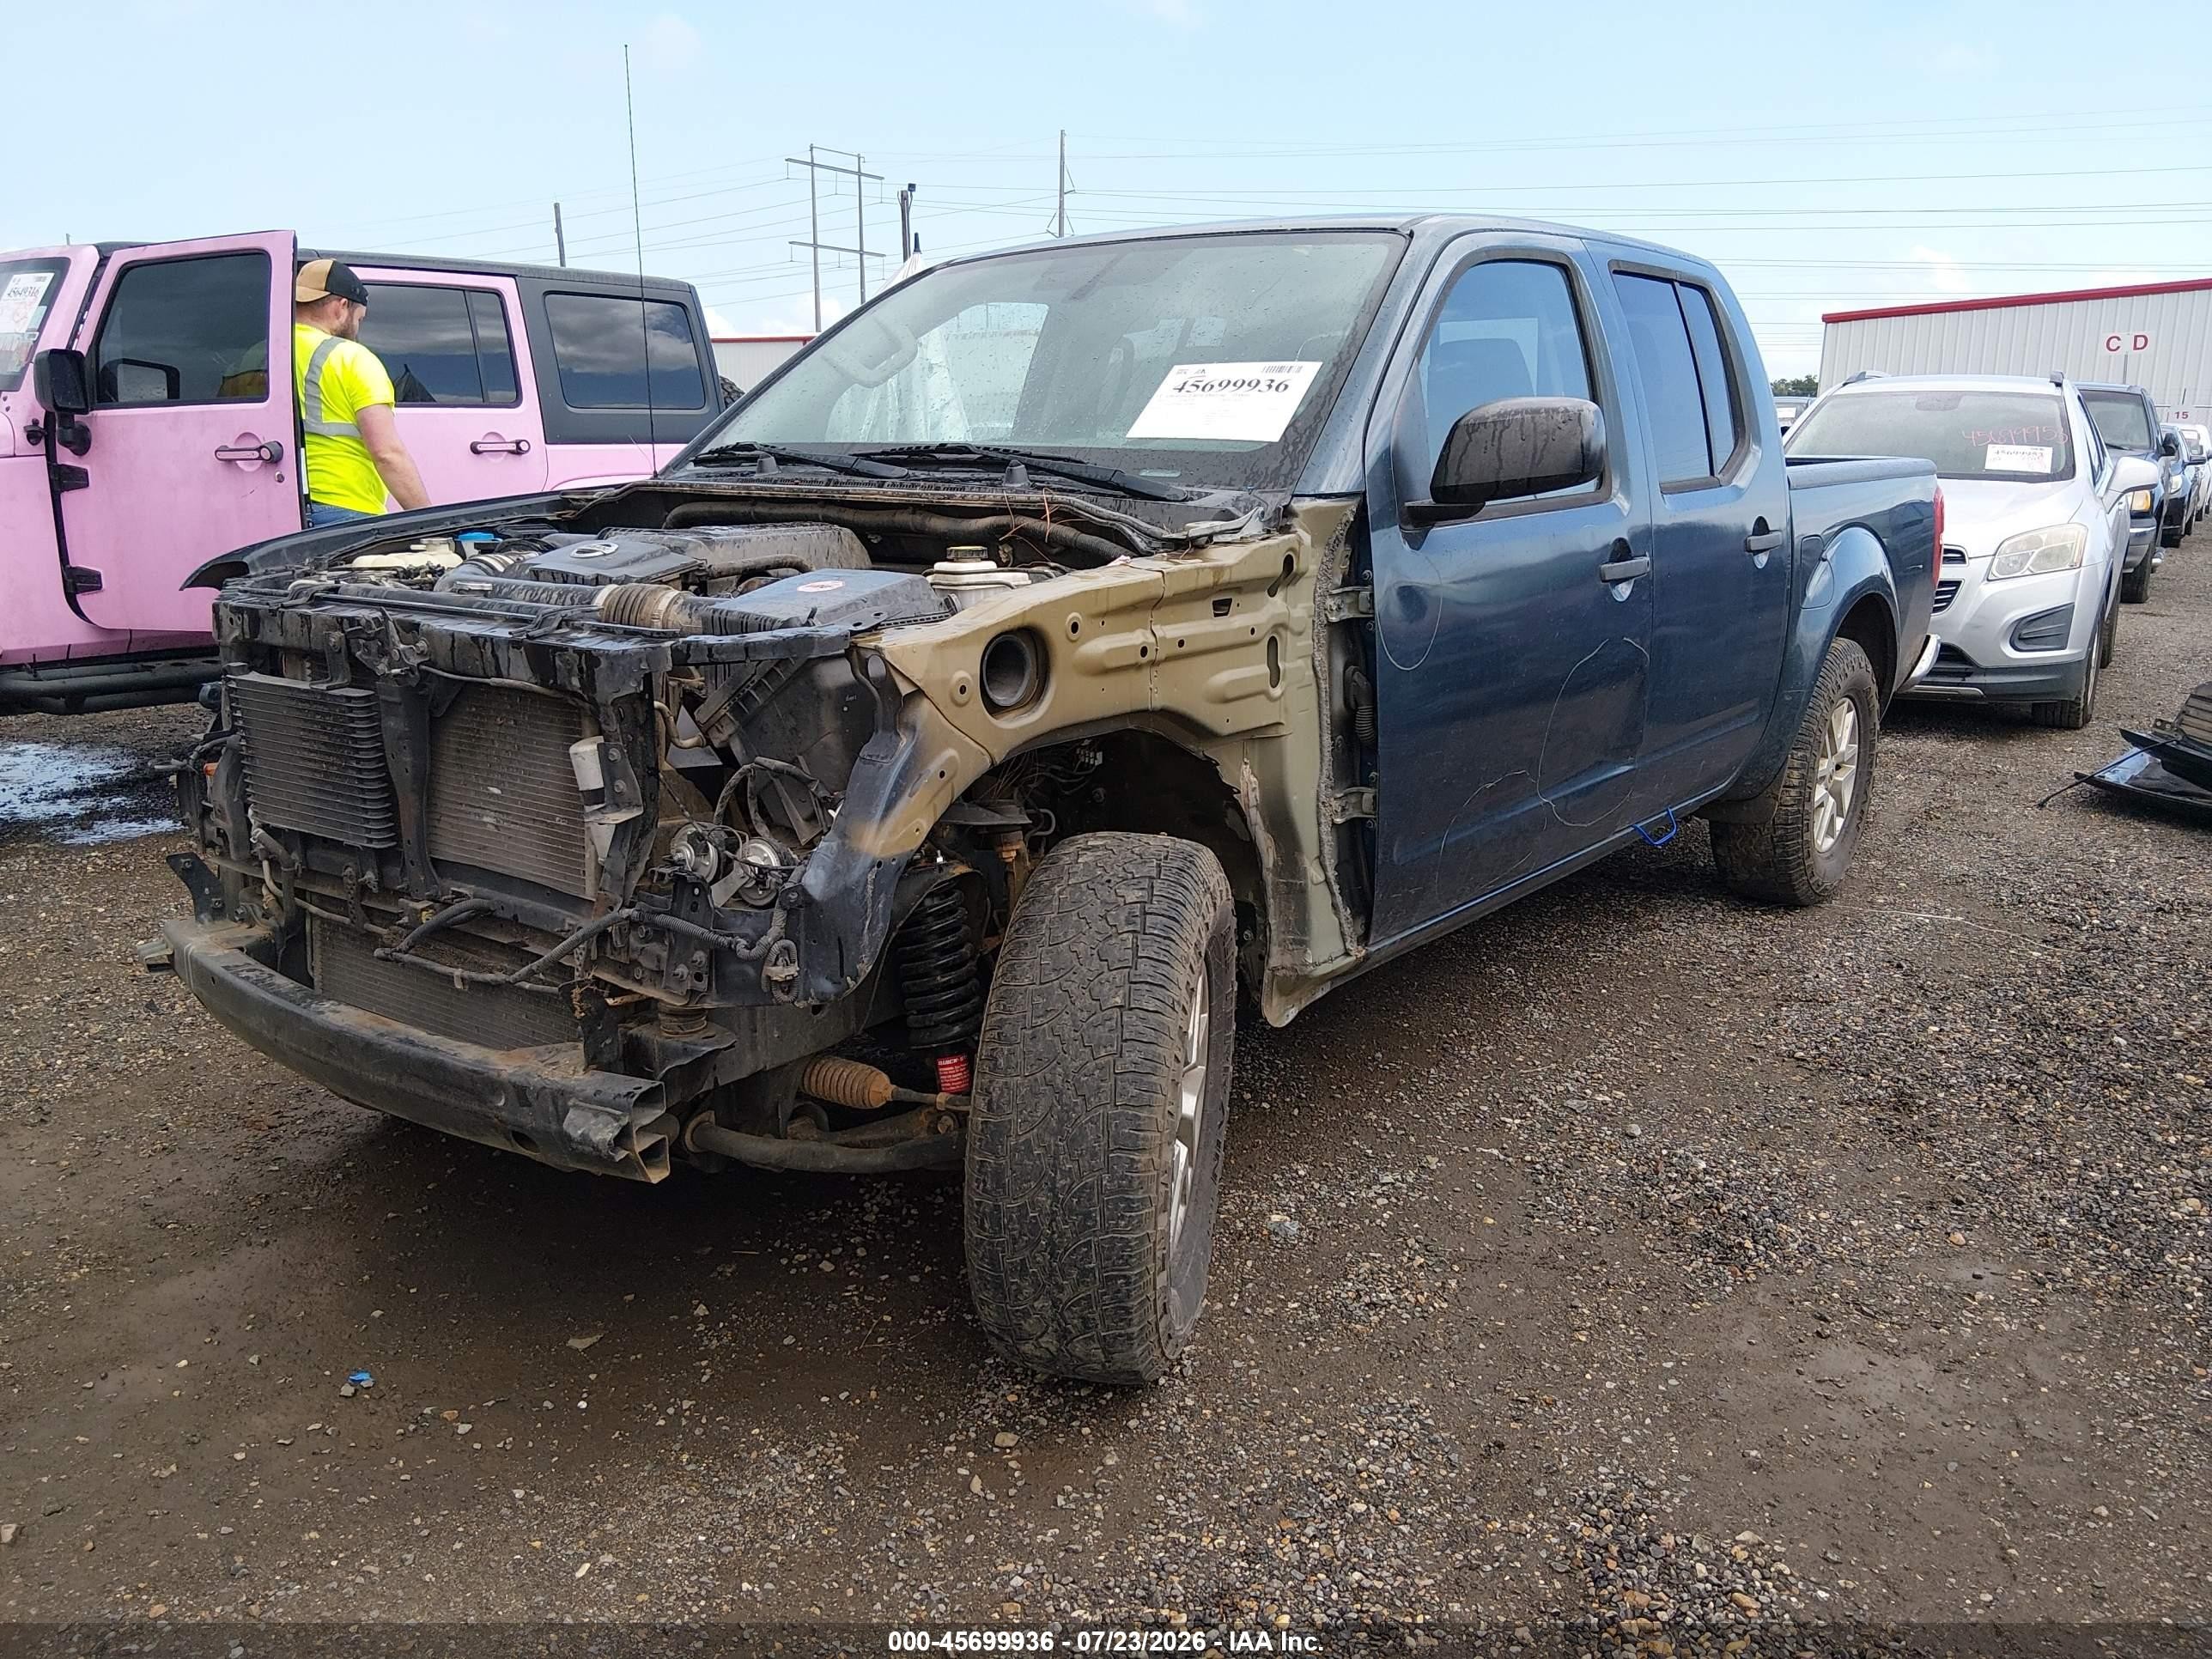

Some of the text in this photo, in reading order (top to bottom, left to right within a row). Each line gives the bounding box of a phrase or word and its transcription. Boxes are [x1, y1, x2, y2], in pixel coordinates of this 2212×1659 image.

[2106, 334, 2148, 352] C D
[1173, 378, 1291, 392] 45699936
[2174, 411, 2189, 420] 15
